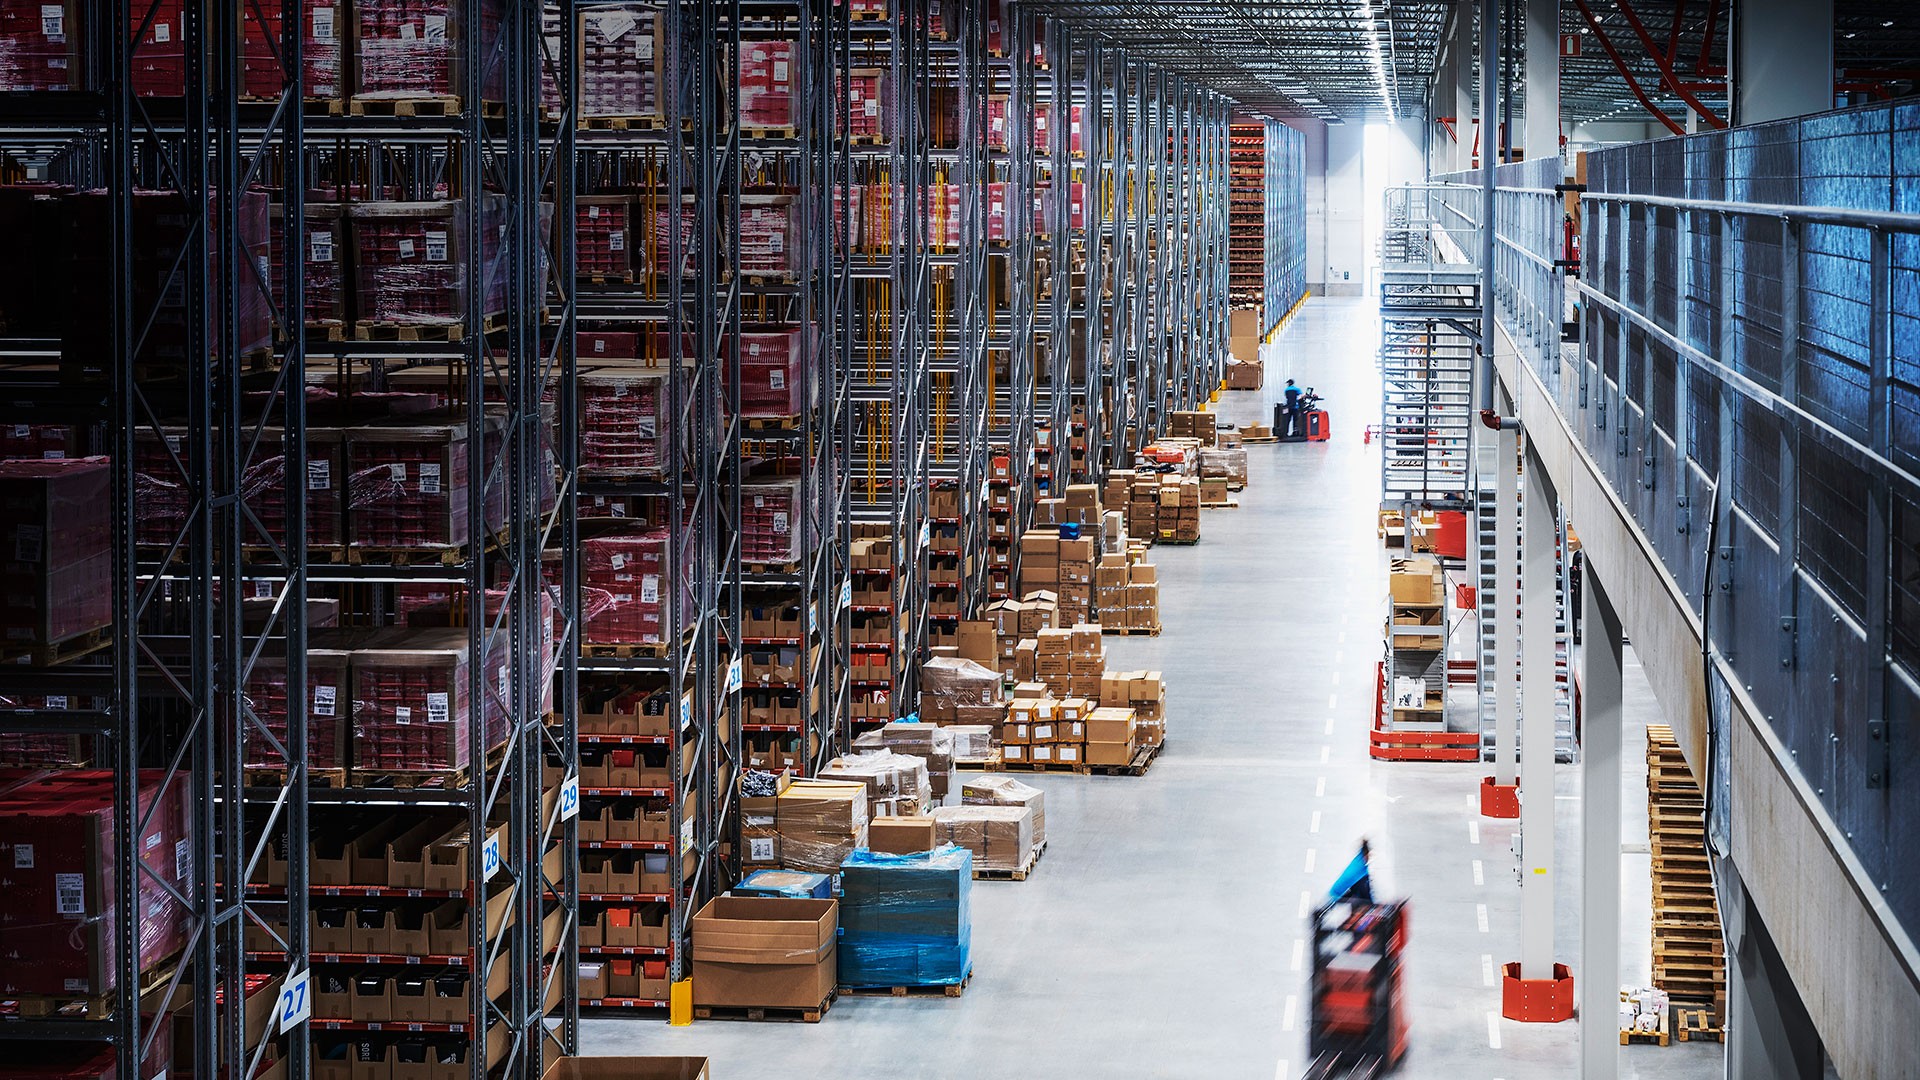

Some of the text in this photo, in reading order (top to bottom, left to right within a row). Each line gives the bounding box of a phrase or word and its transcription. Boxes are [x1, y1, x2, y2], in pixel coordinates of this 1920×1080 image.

[843, 585, 851, 603] 33
[730, 666, 741, 687] 31
[681, 701, 690, 724] 30
[563, 785, 577, 812] 29
[485, 841, 498, 872] 28
[283, 980, 306, 1022] 27
